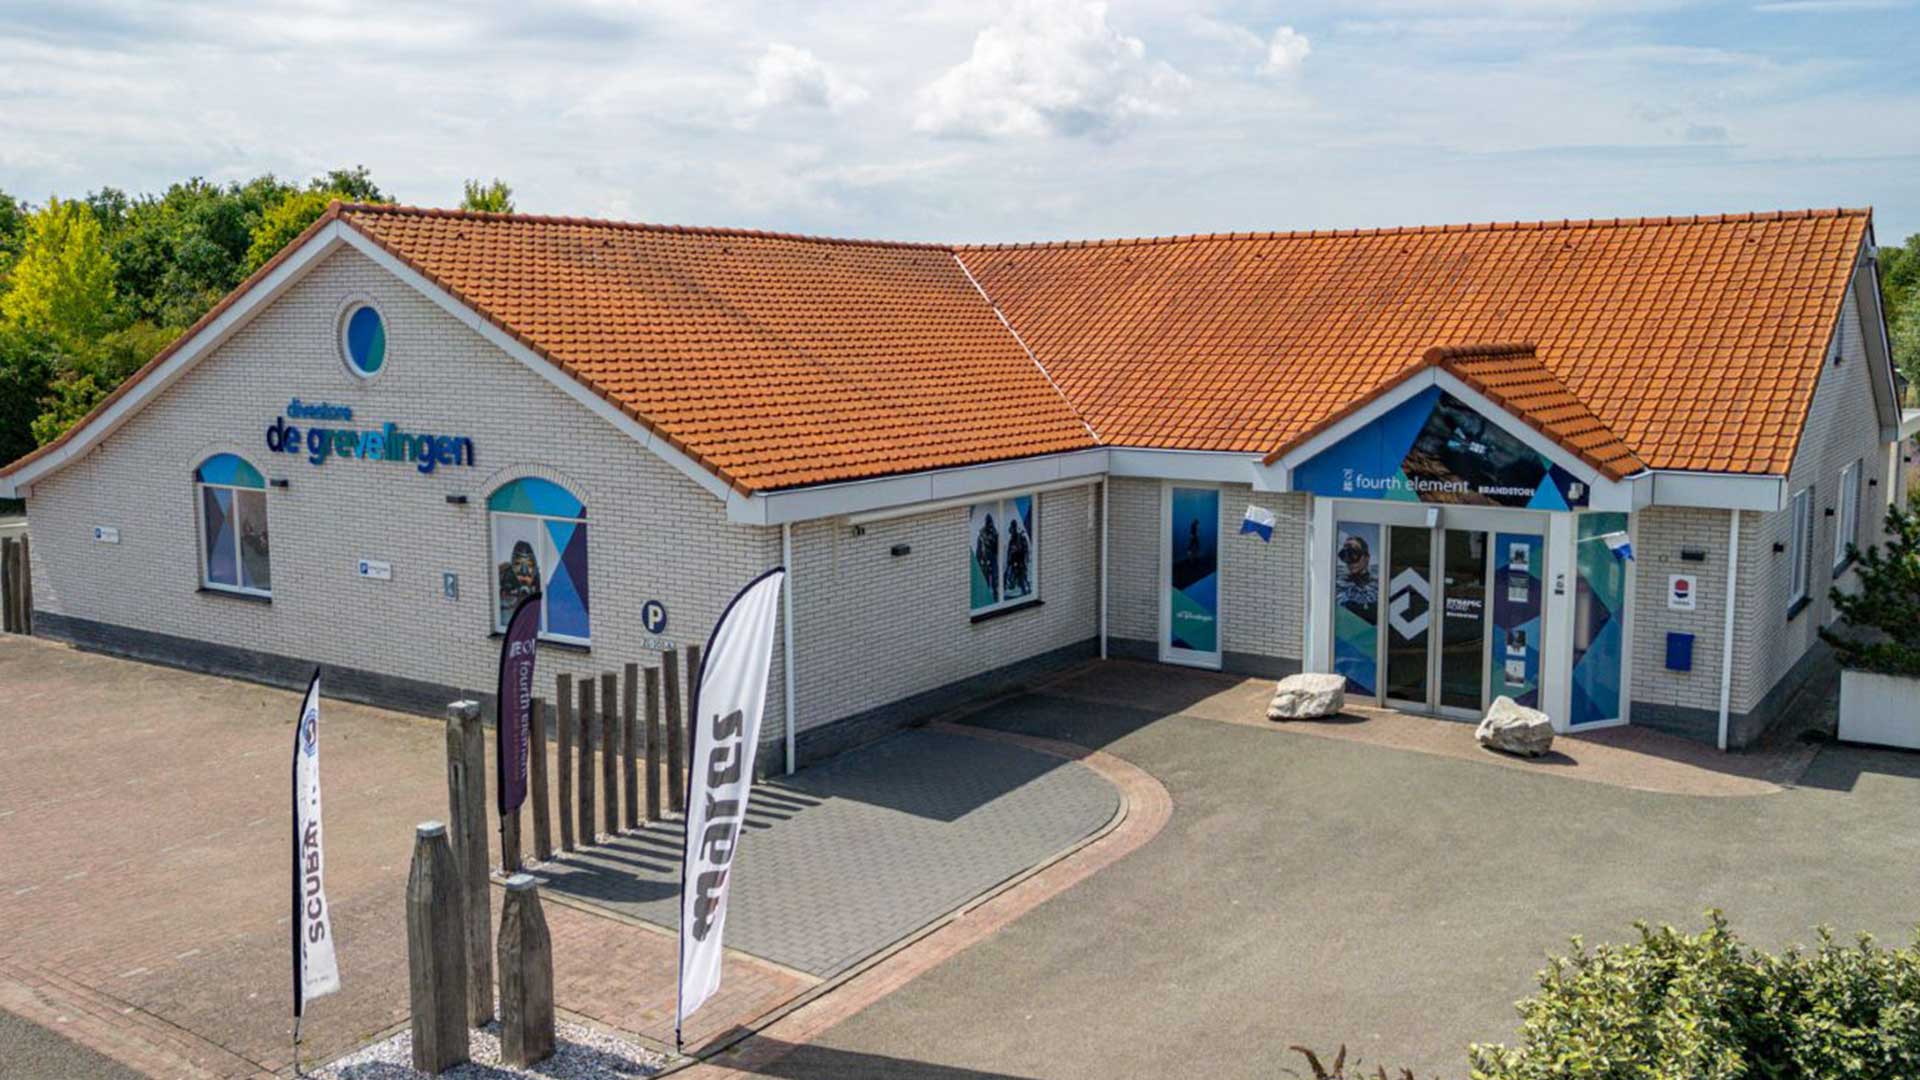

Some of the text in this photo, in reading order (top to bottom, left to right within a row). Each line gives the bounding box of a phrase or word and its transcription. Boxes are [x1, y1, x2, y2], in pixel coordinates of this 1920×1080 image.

[267, 416, 475, 474] de grevelingen
[1356, 474, 1401, 490] fourth
[1405, 475, 1469, 493] element
[518, 659, 531, 710] fourth
[692, 708, 743, 943] mares
